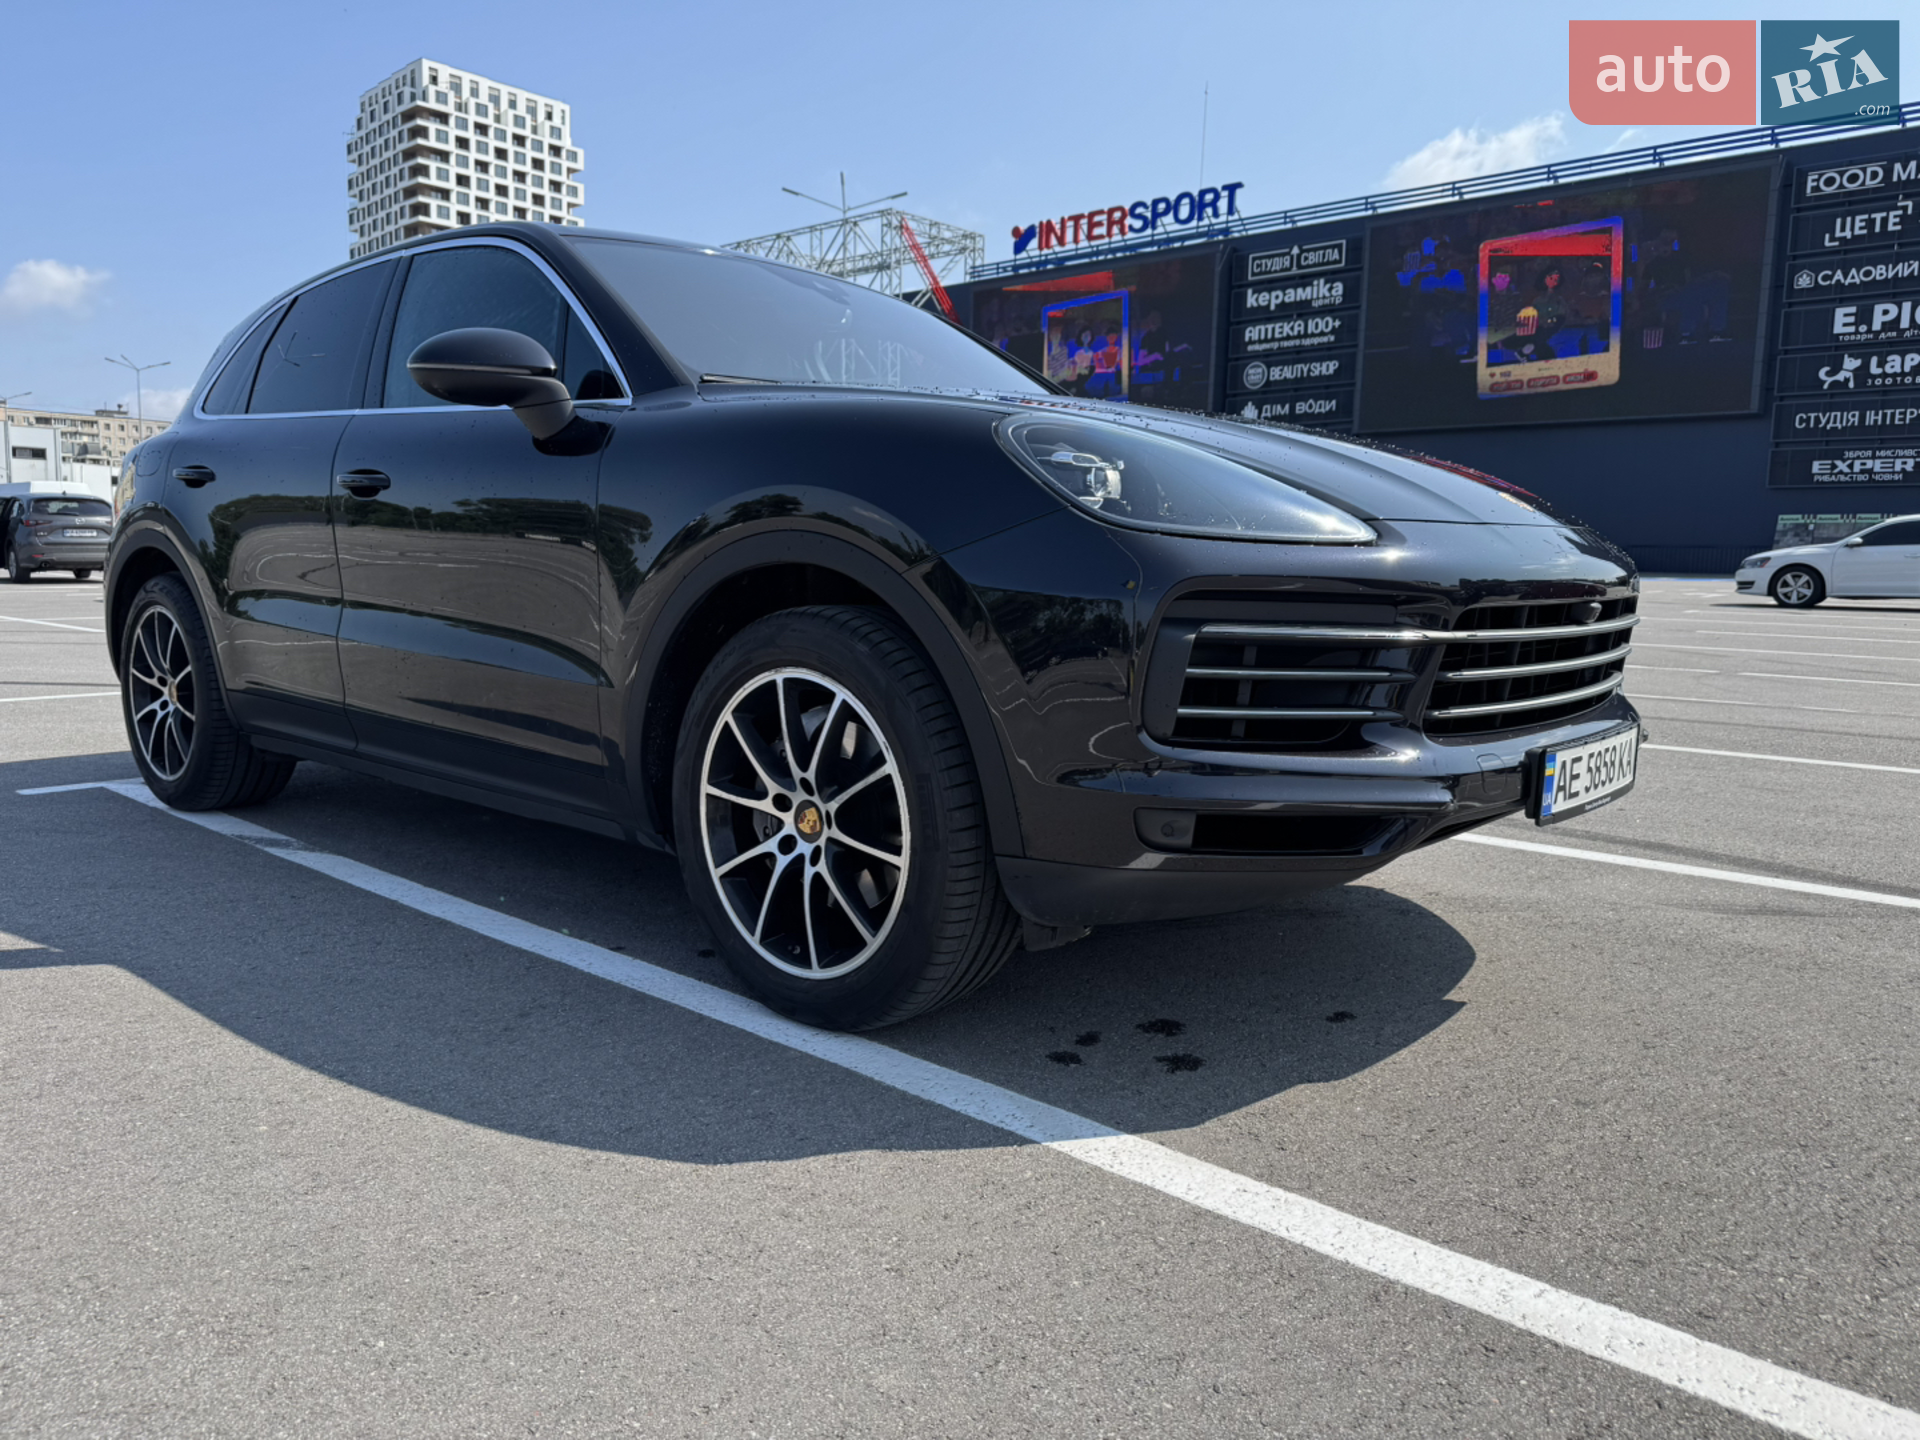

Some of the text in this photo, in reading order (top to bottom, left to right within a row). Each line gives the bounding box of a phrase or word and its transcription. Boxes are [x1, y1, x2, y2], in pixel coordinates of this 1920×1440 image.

[1806, 159, 1920, 195] FOOD M
[1038, 181, 1245, 251] INTERSPORT
[1834, 210, 1903, 239] ЦЕТЕ
[1253, 248, 1340, 273] СТУДІЯ СВІТЛА
[1817, 260, 1919, 286] САДОВИЙ
[1244, 316, 1342, 342] АПТЕКА 100+
[1903, 329, 1920, 338] діт
[1269, 363, 1310, 381] BEAUTY
[1310, 360, 1339, 377] SHOP
[1260, 398, 1337, 419] ДІМ ВОДИ
[1795, 411, 1859, 430] СТУДІЯ
[1875, 448, 1920, 458] МИСЛИВС
[1553, 737, 1633, 805] AE 5858 KA
